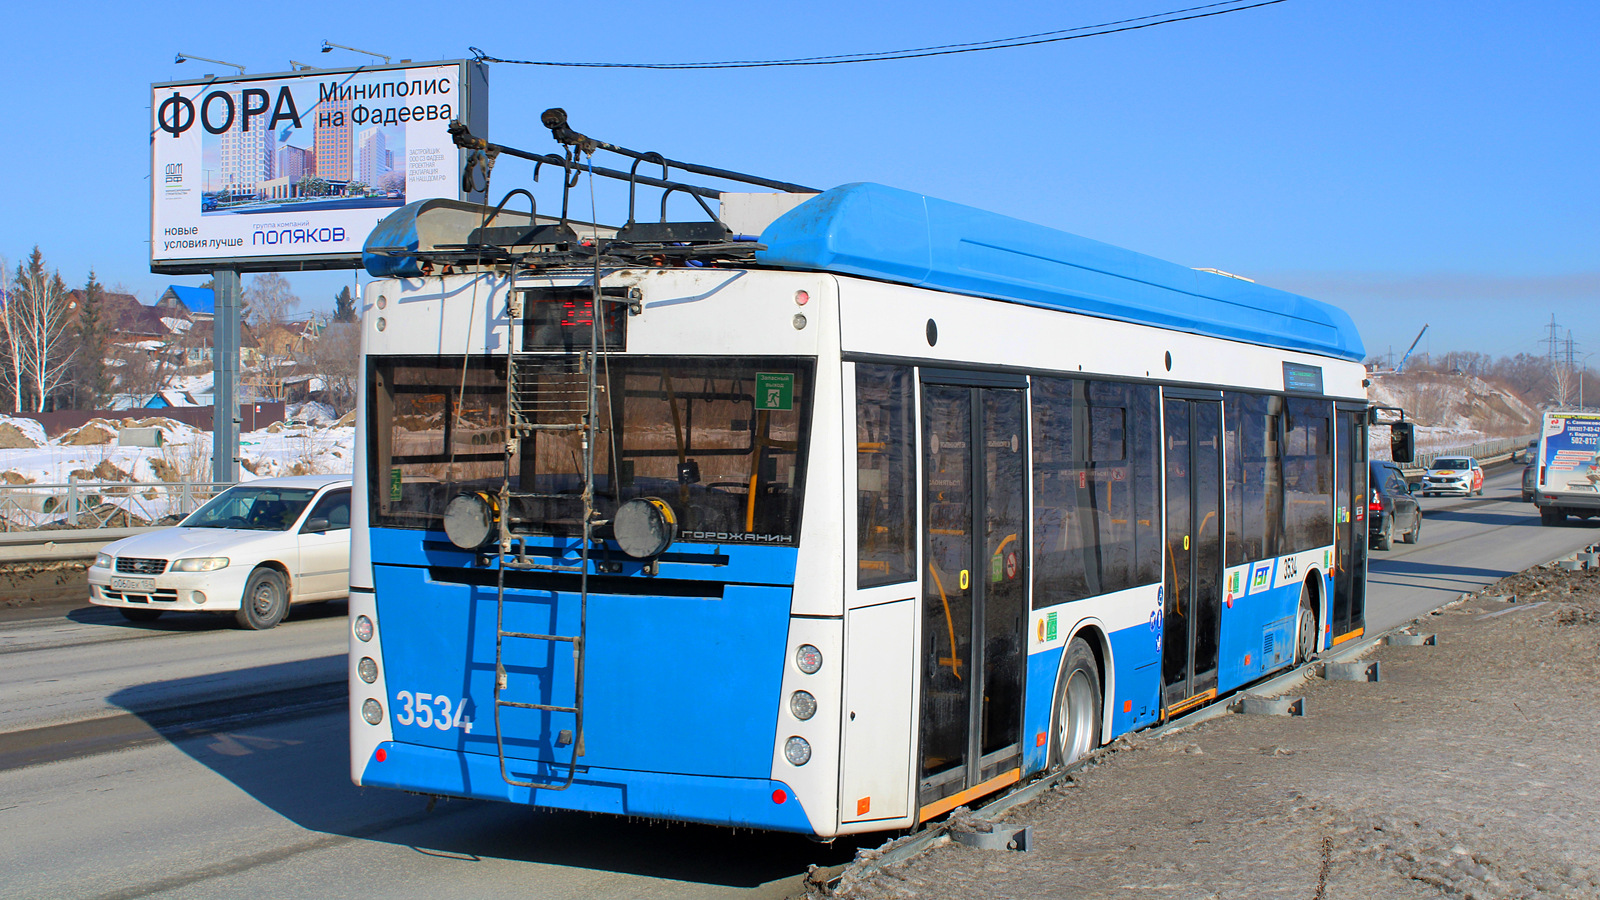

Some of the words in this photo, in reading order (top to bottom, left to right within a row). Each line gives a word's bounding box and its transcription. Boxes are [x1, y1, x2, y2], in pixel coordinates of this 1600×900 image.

[319, 78, 451, 102] Миниполис
[158, 85, 302, 138] ФОРА
[319, 109, 344, 128] на
[351, 103, 451, 127] Фадеева
[164, 226, 198, 236] новые
[164, 240, 208, 251] условия
[209, 237, 243, 249] лучше
[681, 530, 792, 542] ГОРОЖАНИН
[1284, 556, 1297, 580] 3534
[396, 690, 473, 734] 3534
